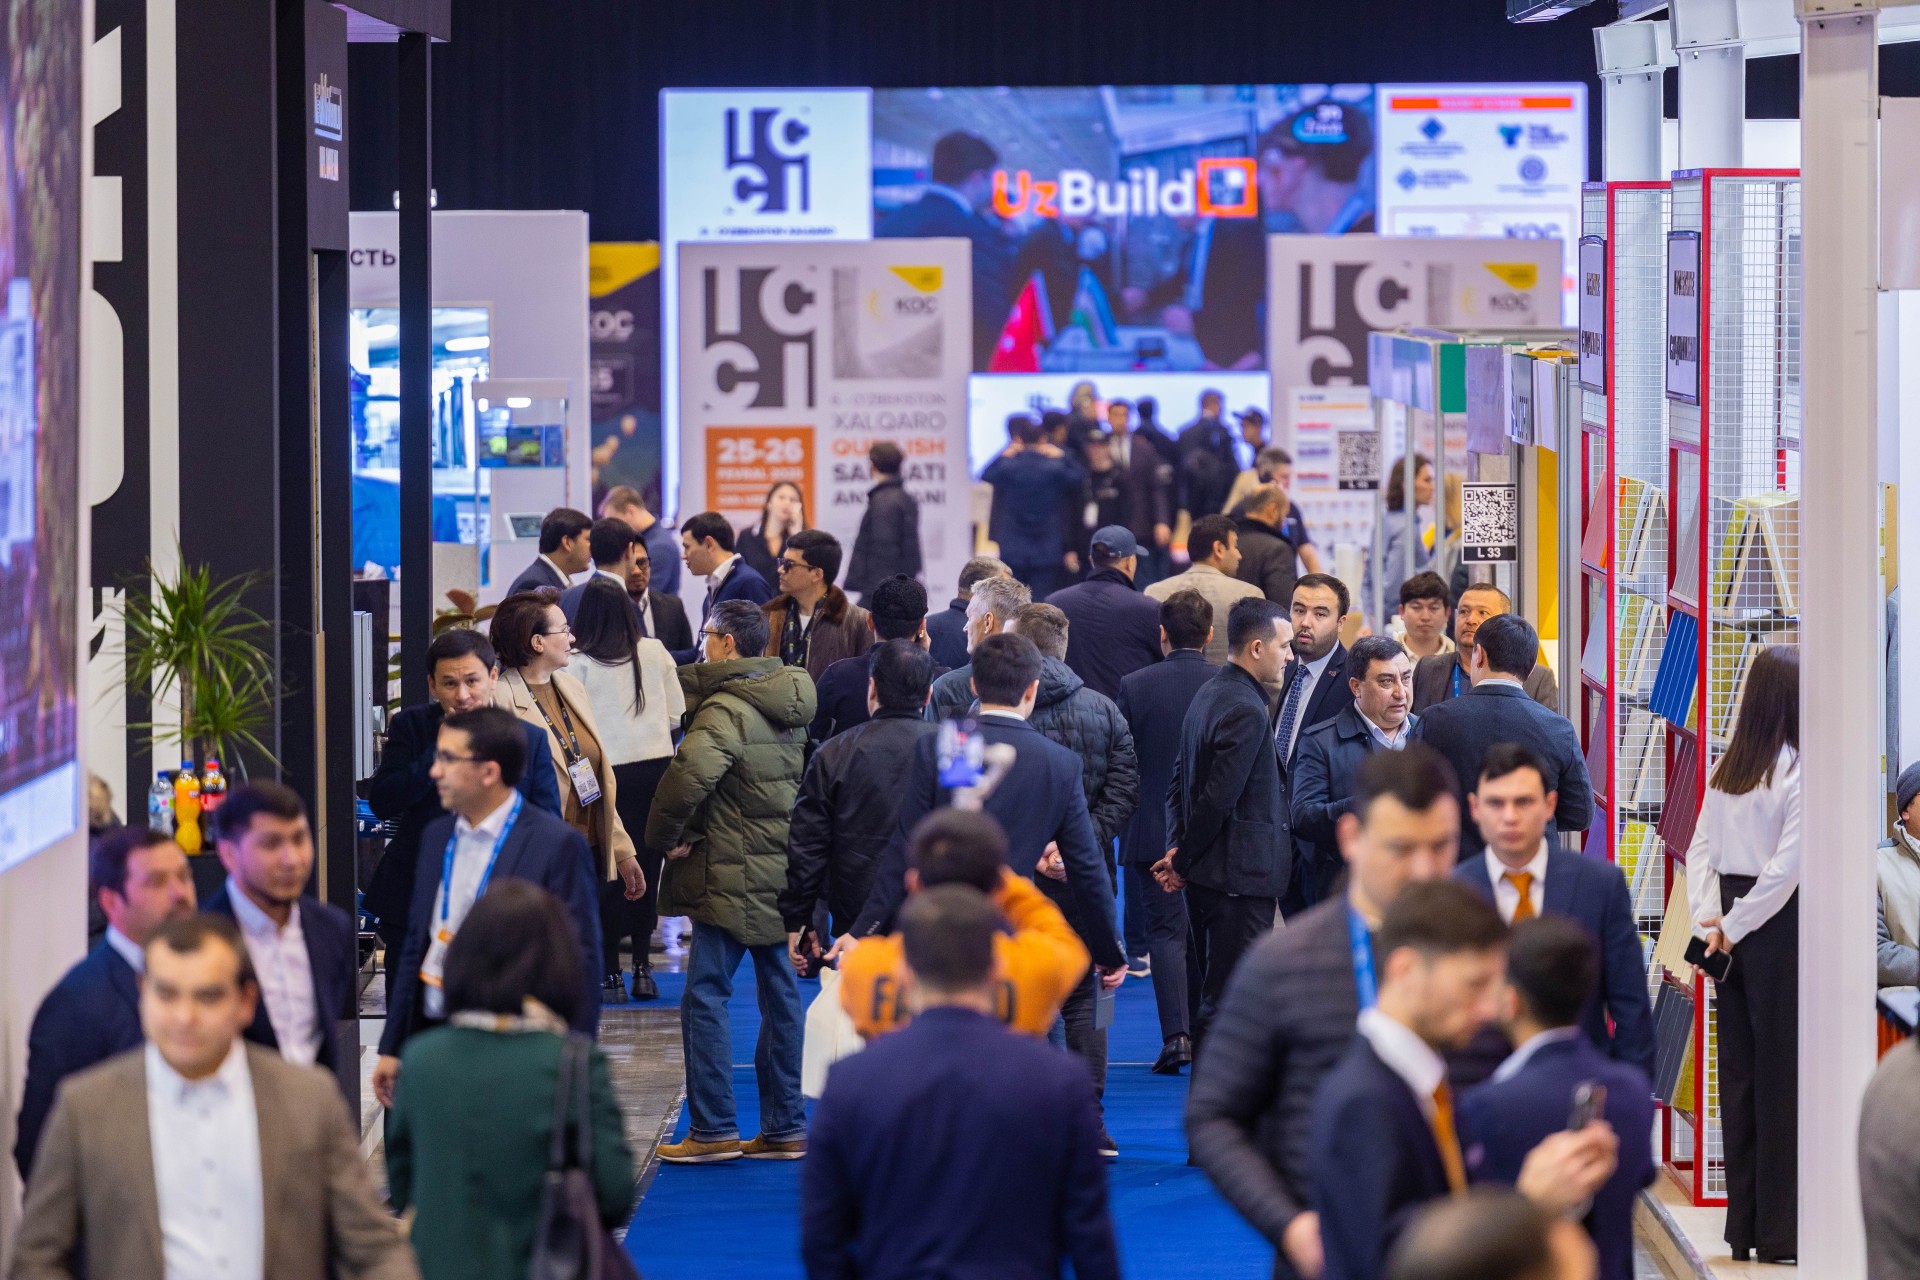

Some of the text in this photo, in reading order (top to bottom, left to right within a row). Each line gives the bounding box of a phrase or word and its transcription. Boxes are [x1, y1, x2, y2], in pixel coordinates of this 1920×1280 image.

[992, 167, 1196, 218] UzBuild
[350, 249, 396, 266] СТЬ
[833, 411, 947, 431] XALQARO
[717, 437, 805, 464] 25-26
[831, 438, 945, 456] QUISH
[833, 462, 945, 481] SAATI
[1477, 547, 1501, 558] L 33
